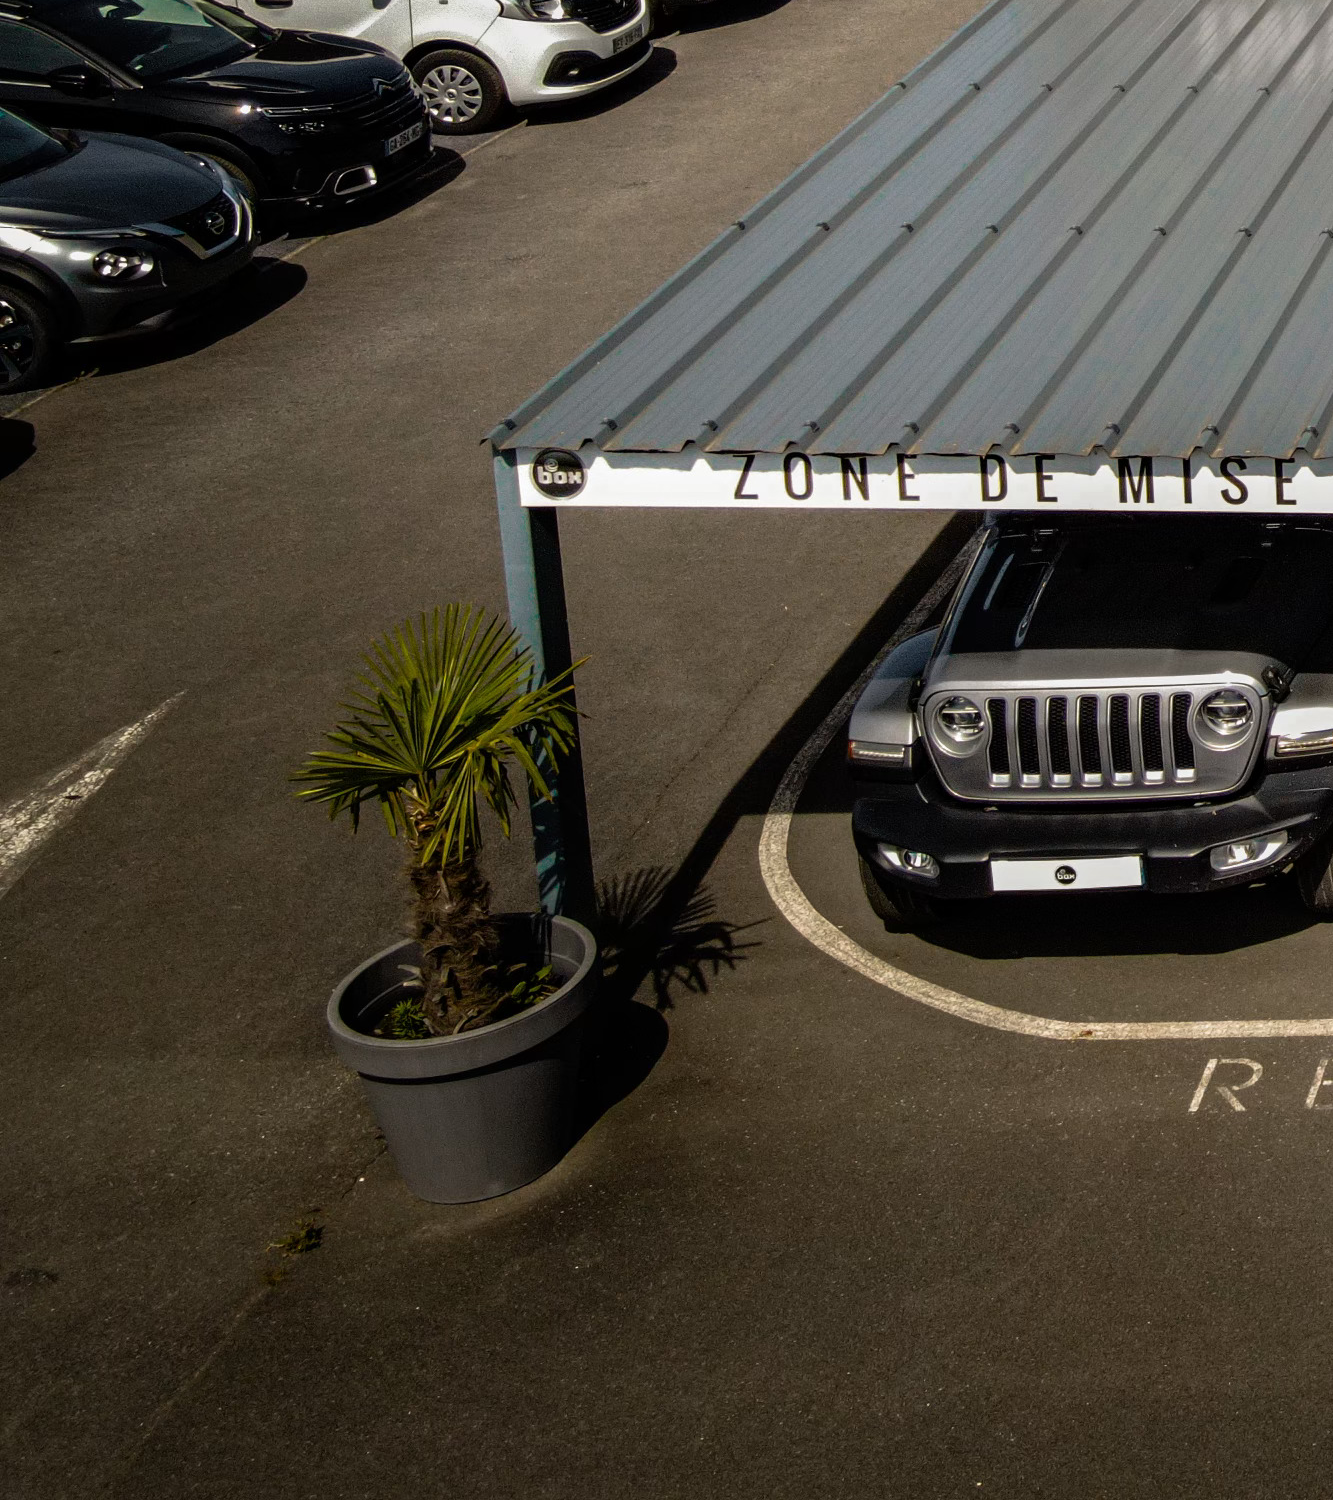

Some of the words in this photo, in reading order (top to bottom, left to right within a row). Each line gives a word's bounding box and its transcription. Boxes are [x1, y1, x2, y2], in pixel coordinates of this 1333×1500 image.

[536, 465, 582, 485] box
[733, 452, 920, 502] ZONE
[981, 454, 1059, 503] DE
[1117, 456, 1298, 506] MISE
